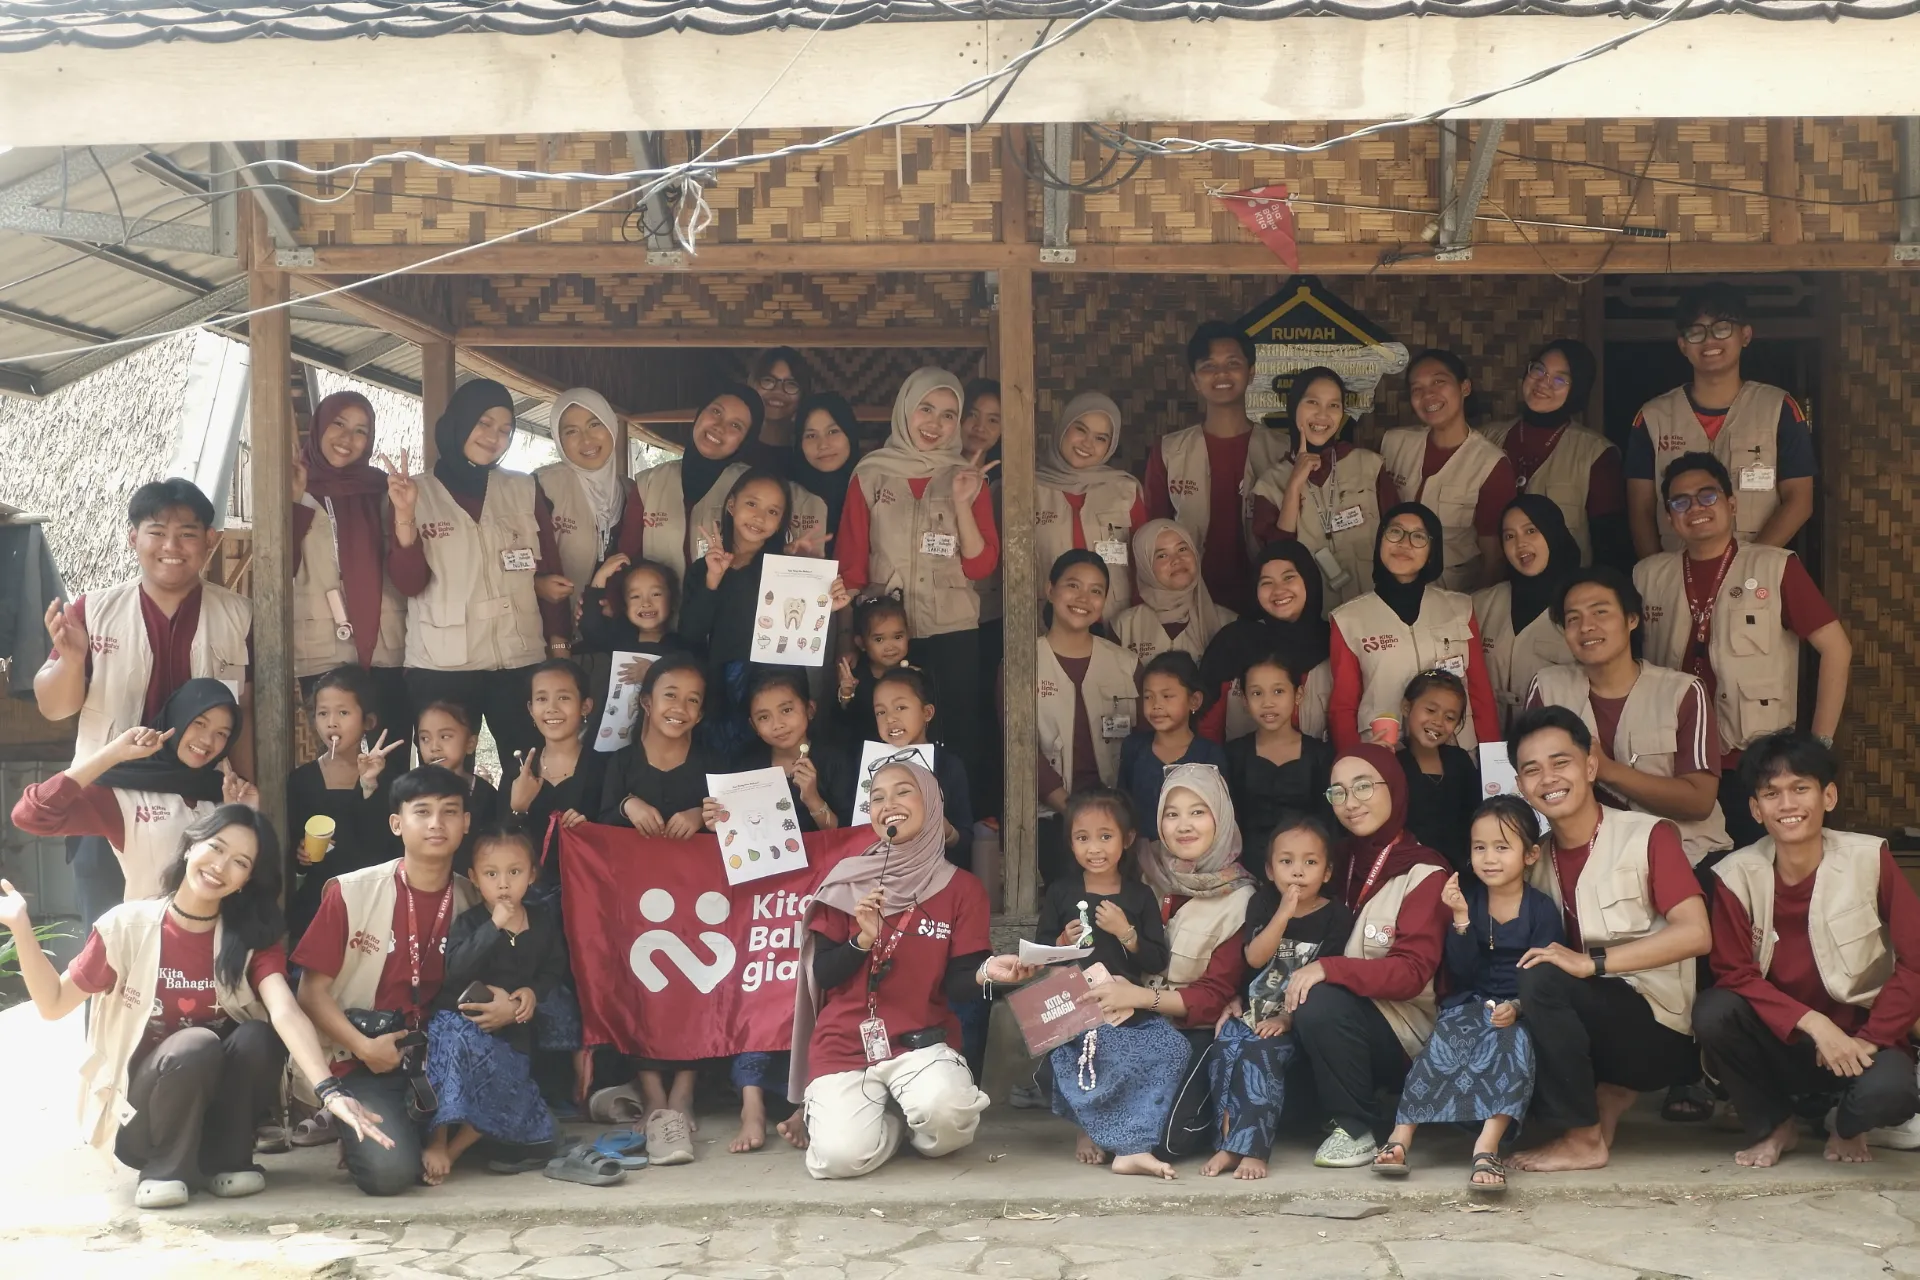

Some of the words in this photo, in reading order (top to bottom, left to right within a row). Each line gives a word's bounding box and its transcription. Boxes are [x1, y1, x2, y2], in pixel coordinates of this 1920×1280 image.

[1272, 328, 1336, 340] RUMAH
[937, 921, 950, 929] Kita
[366, 933, 381, 945] Kita
[363, 939, 380, 953] Baha
[158, 967, 184, 979] Kita
[165, 977, 217, 992] Bahagia
[1044, 994, 1064, 1011] KITA
[1040, 1000, 1076, 1024] BAHAGIA
